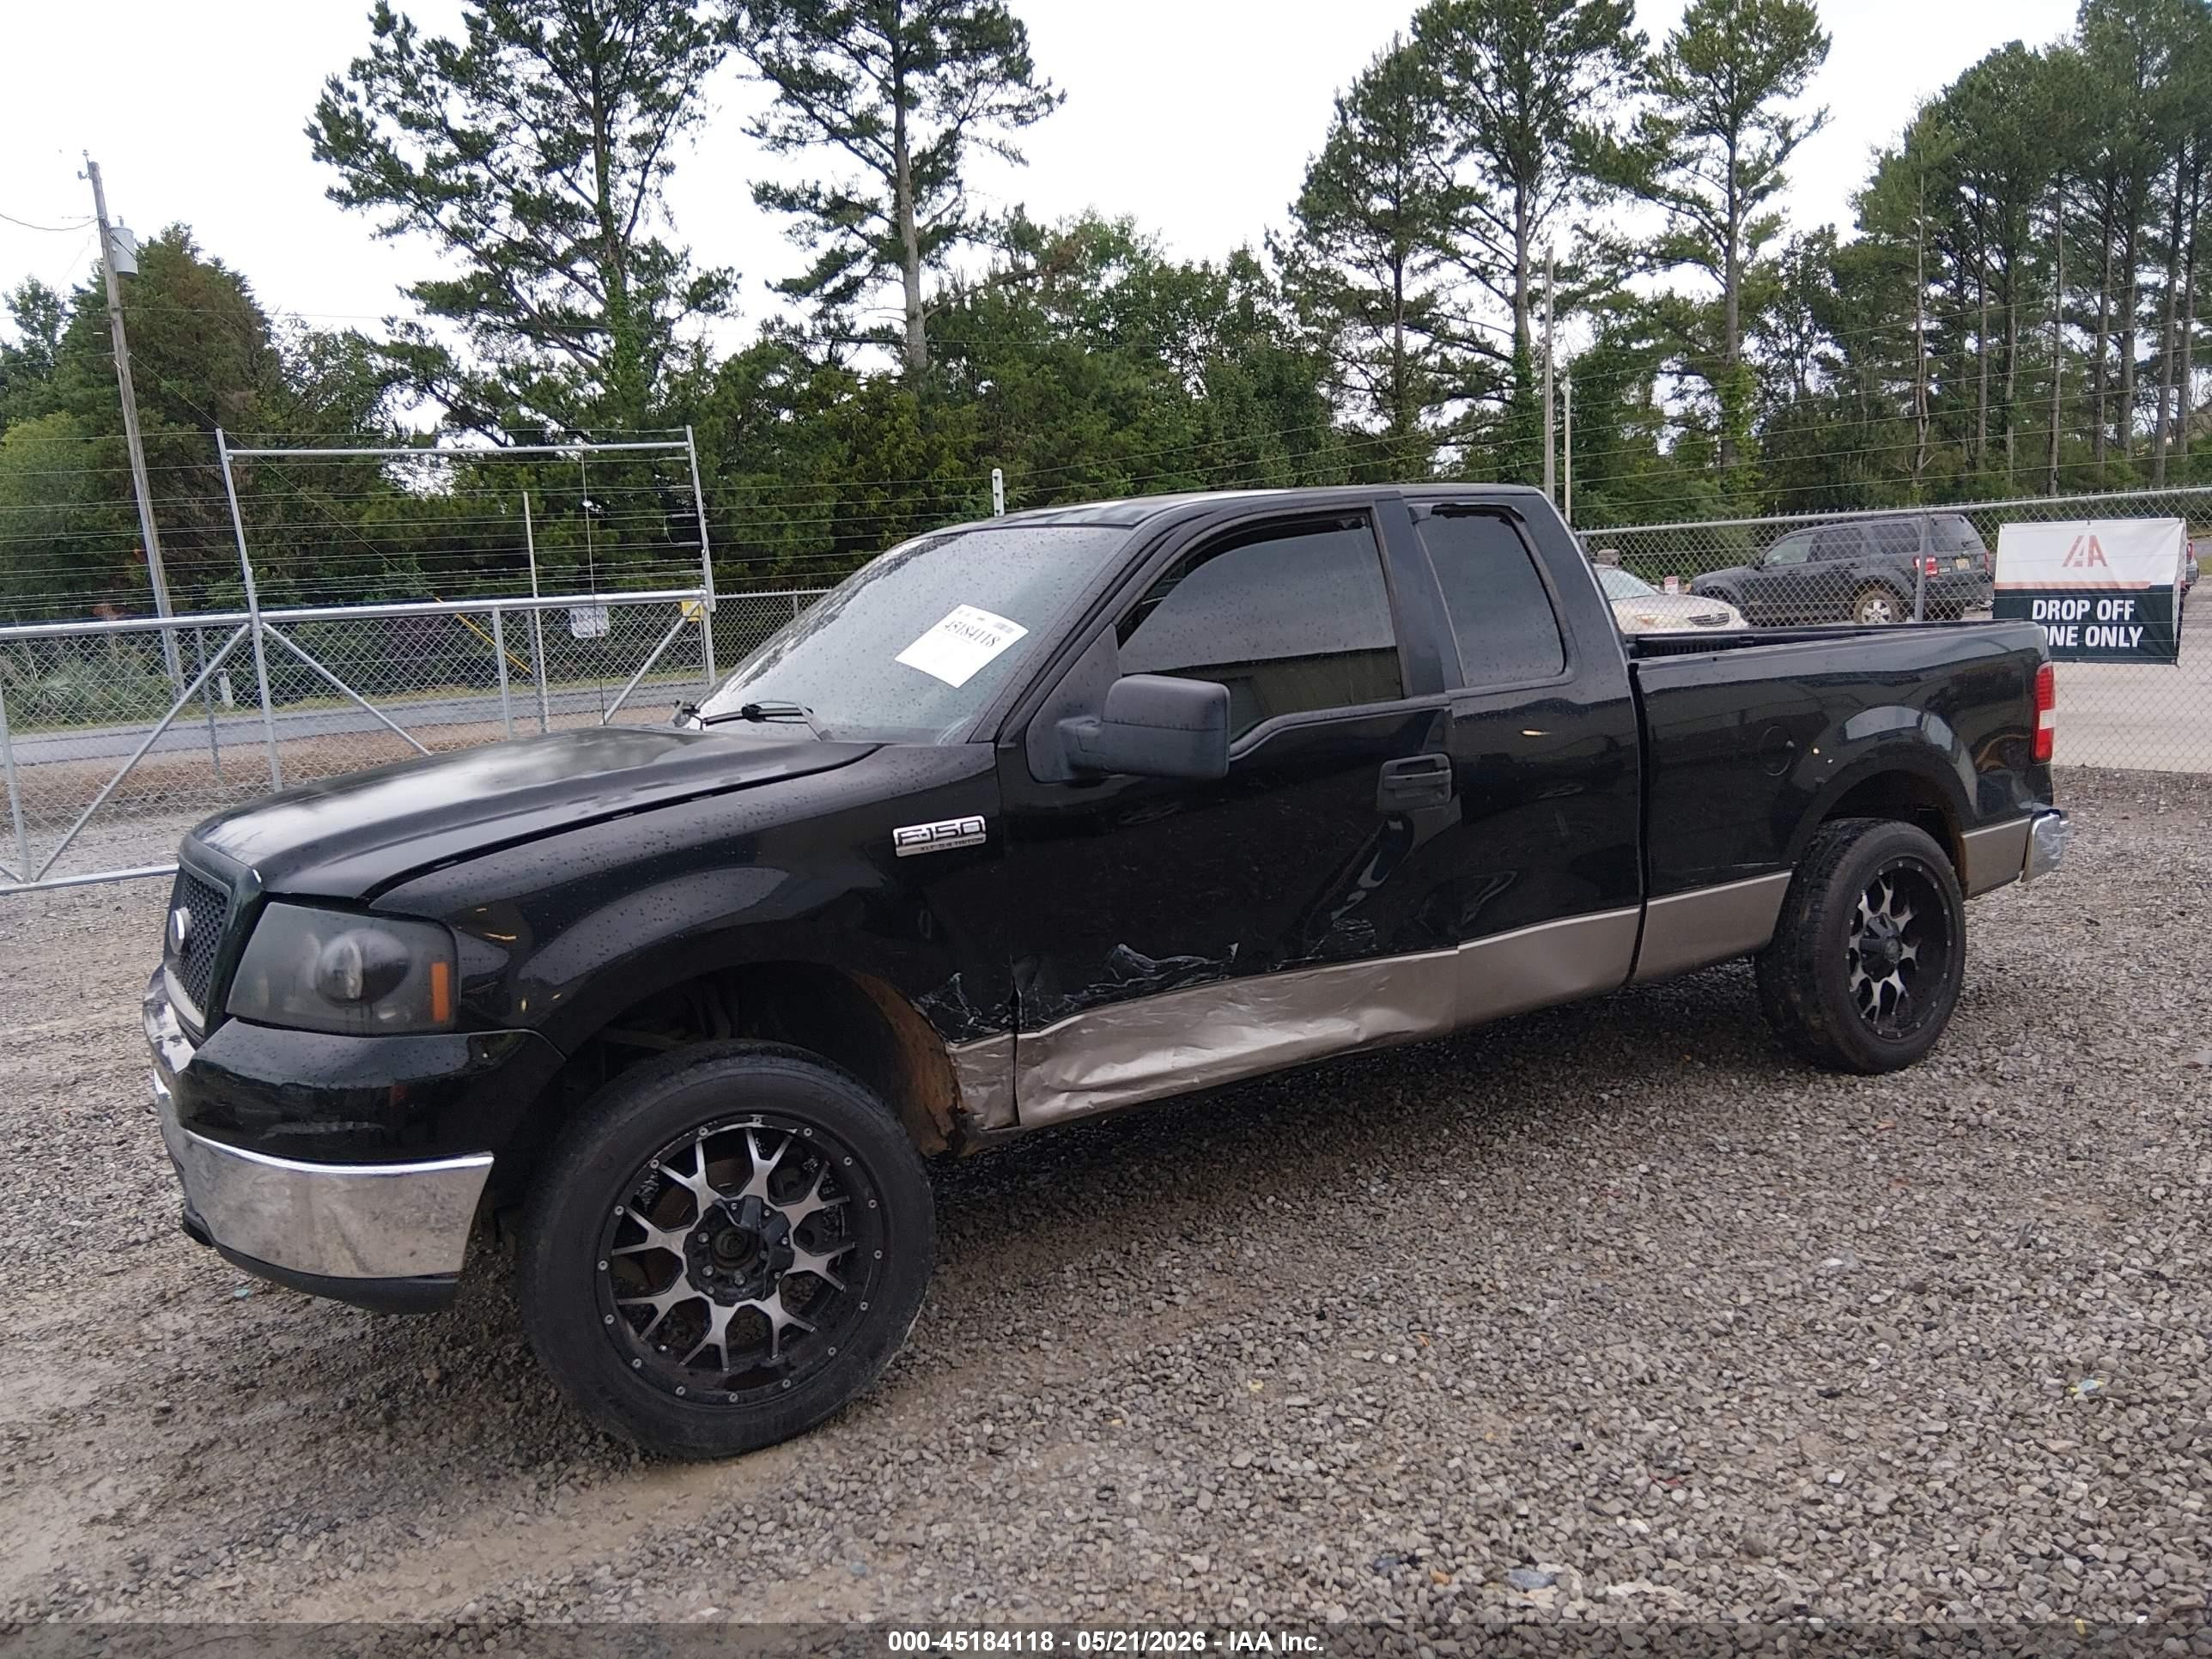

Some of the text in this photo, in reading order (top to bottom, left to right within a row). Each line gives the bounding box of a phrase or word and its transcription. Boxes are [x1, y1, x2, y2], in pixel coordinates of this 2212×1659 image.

[2032, 599, 2135, 621] DROP OFF
[2043, 625, 2143, 647] NE ONLY
